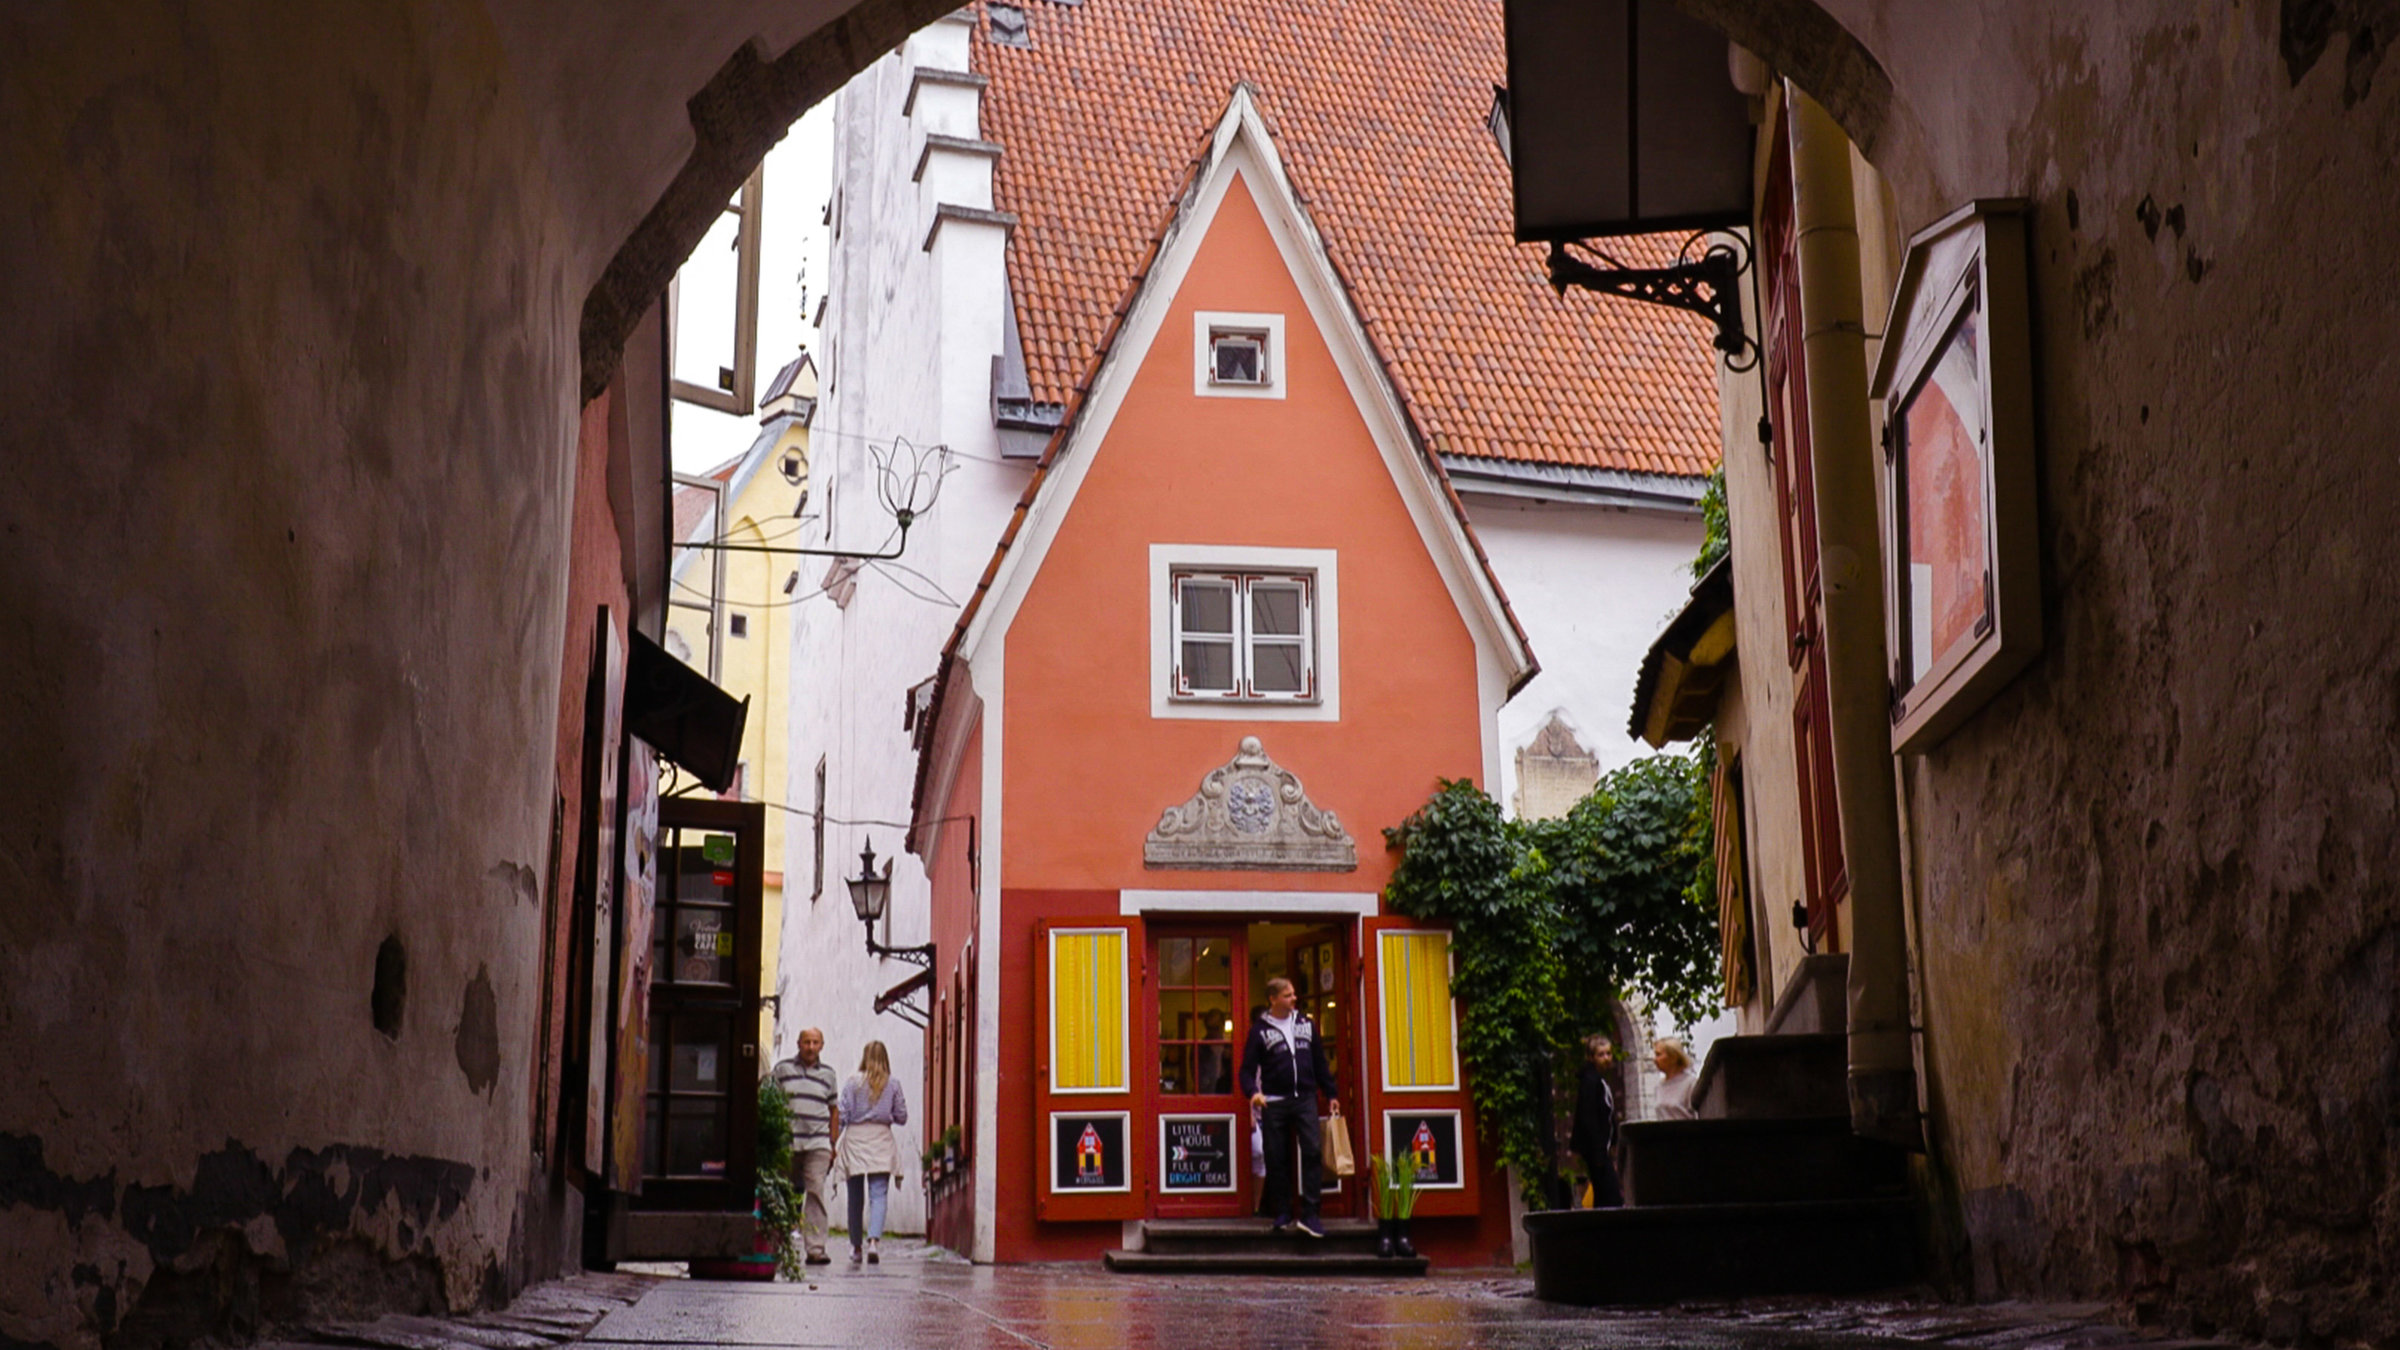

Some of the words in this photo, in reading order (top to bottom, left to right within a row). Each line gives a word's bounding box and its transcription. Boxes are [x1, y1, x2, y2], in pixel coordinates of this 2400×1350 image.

[1172, 1124, 1201, 1135] LITTLE
[1180, 1135, 1212, 1147] HOUSE
[1172, 1161, 1195, 1172] FULL
[1199, 1161, 1212, 1172] OF
[1169, 1172, 1202, 1184] BRIGHT
[1205, 1172, 1227, 1184] IDEAS
